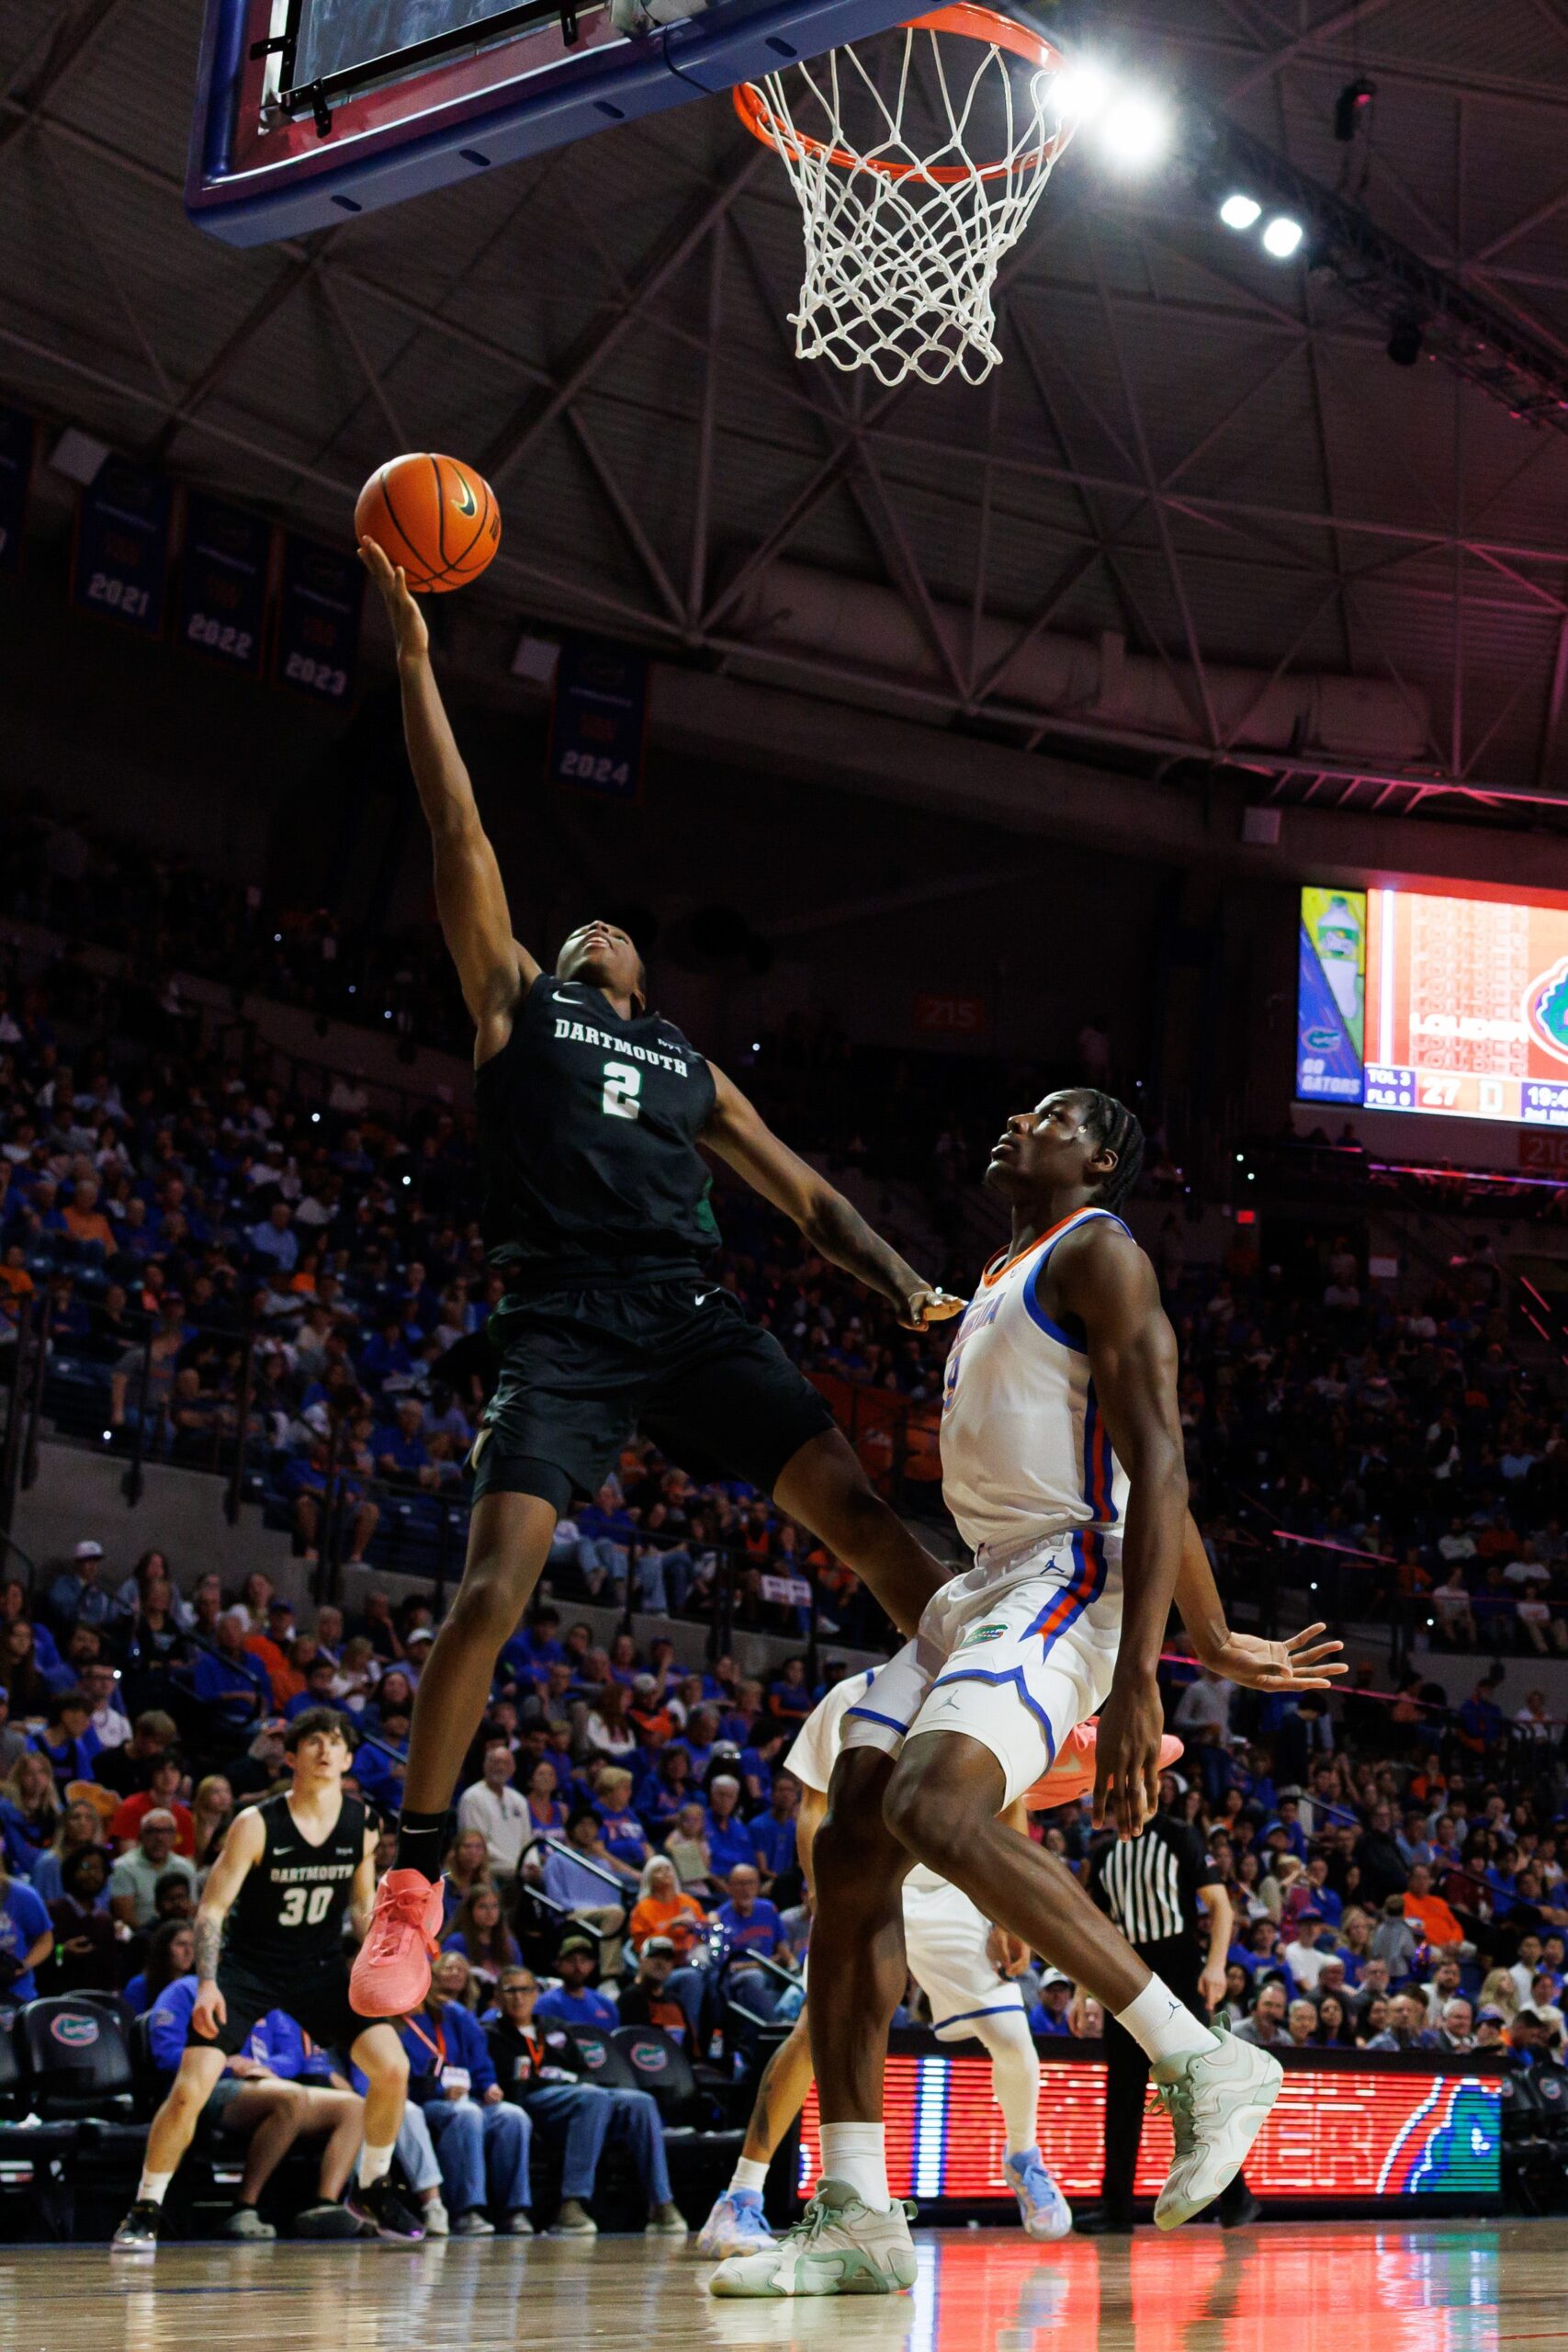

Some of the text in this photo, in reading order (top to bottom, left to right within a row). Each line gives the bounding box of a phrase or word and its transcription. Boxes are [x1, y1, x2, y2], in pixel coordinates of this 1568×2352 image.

[88, 572, 149, 617] 2021
[186, 613, 253, 660] 2022
[285, 651, 347, 696] 2023
[559, 751, 630, 786] 2024
[926, 1000, 976, 1027] 215
[554, 1018, 688, 1078] DARTMOUTH
[603, 1061, 641, 1120] 2
[1367, 1089, 1396, 1104] FLS
[1368, 1069, 1411, 1086] TOL 3
[1422, 1076, 1461, 1106] 27
[277, 1886, 334, 1926] 30
